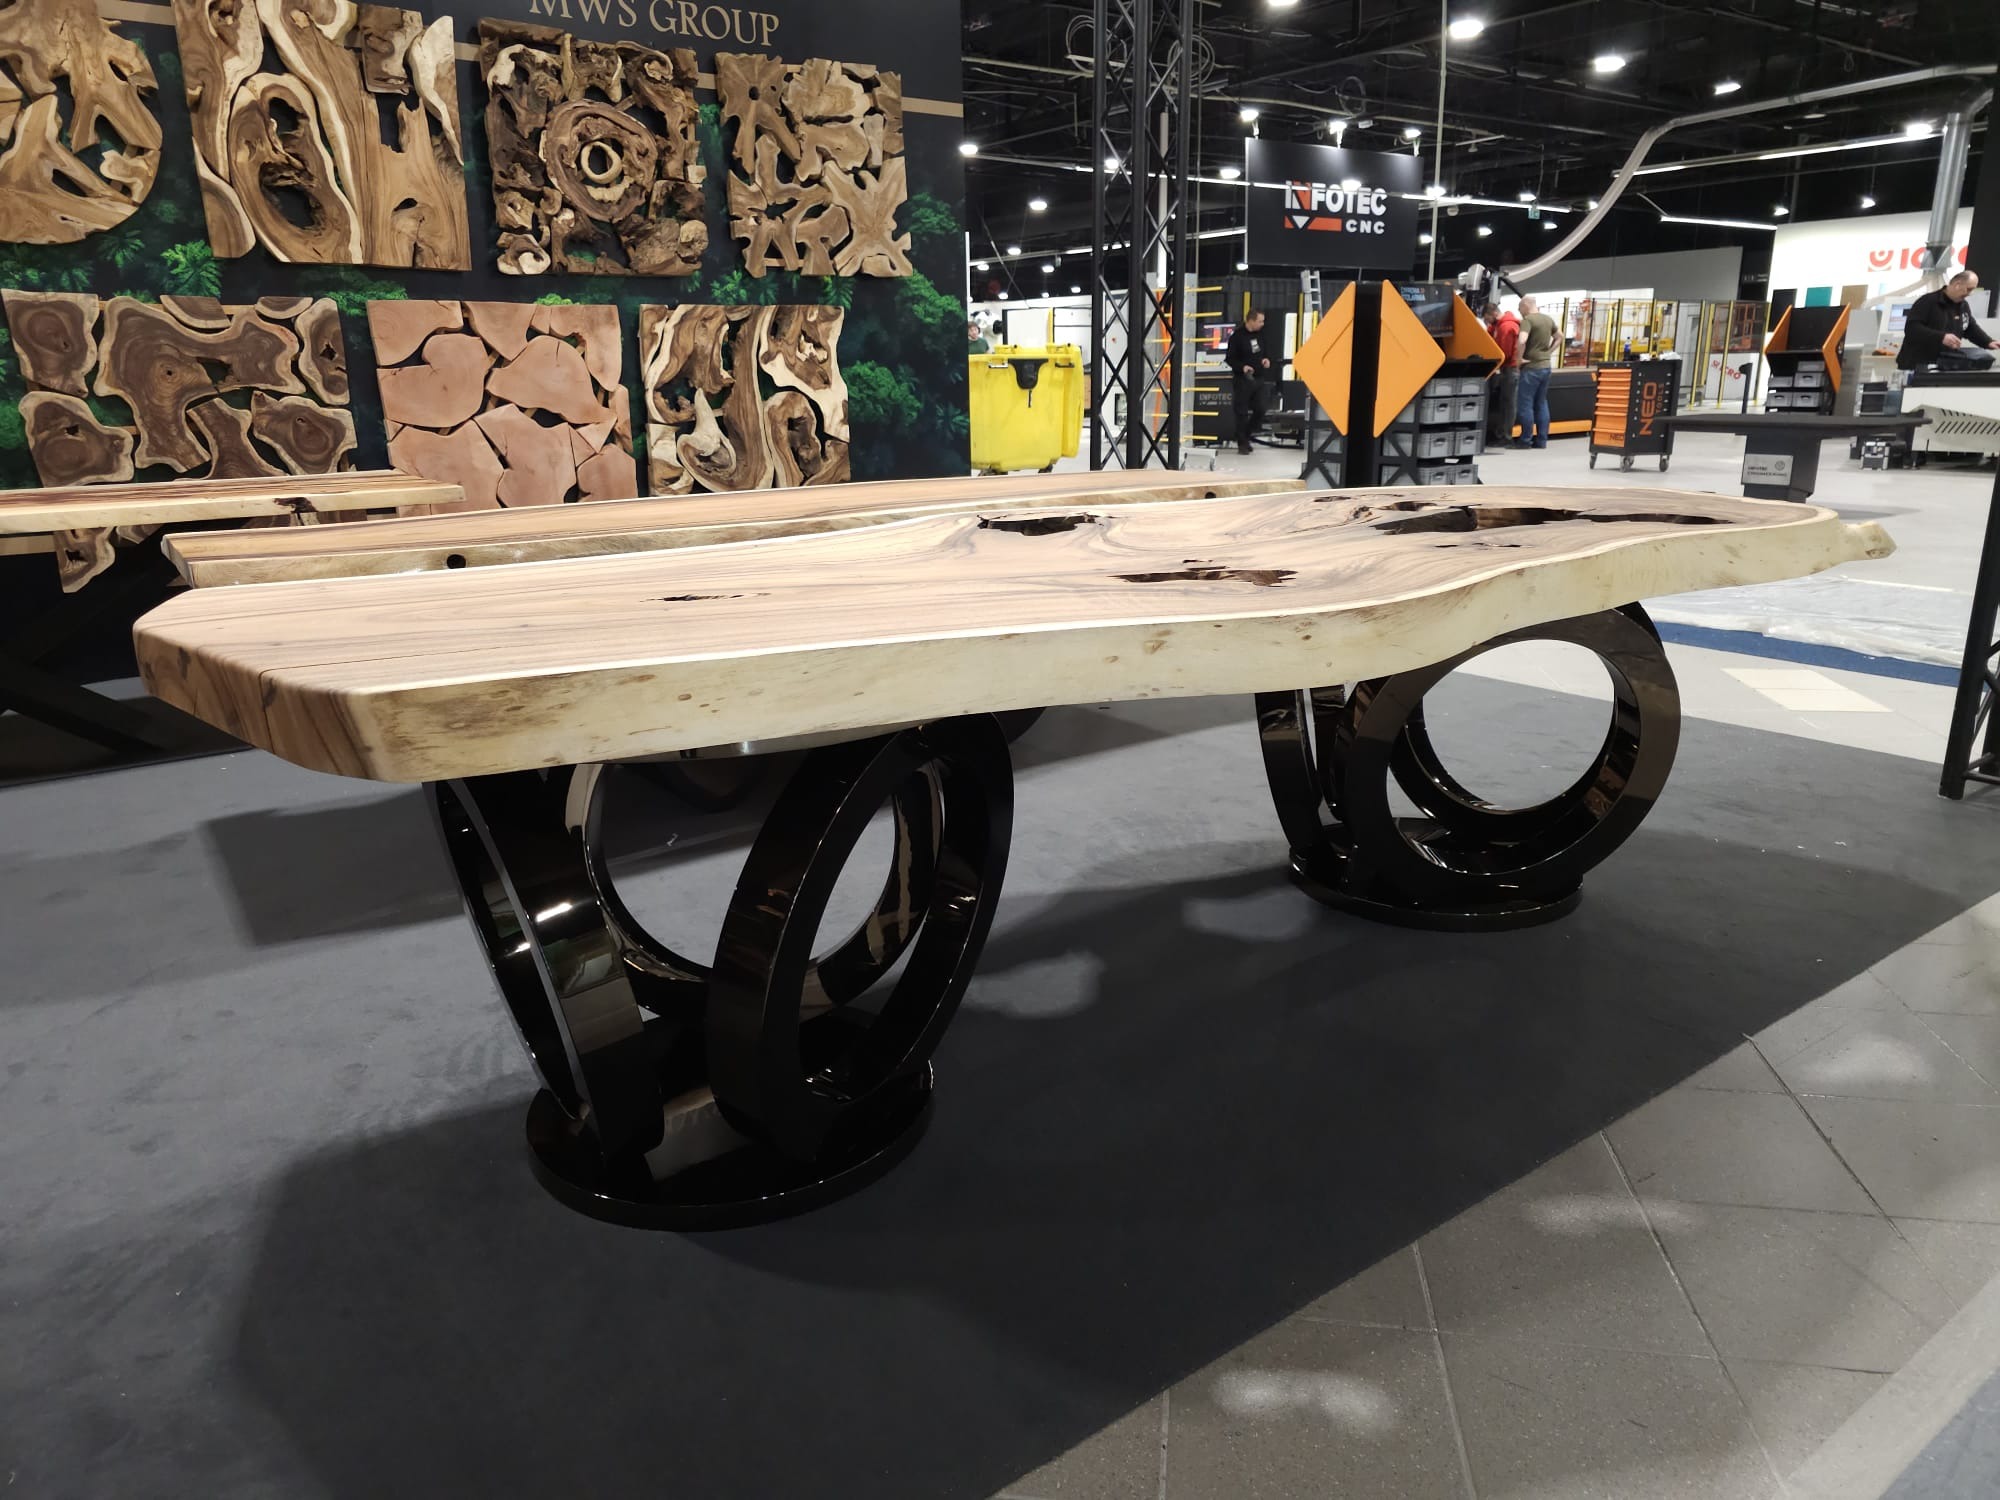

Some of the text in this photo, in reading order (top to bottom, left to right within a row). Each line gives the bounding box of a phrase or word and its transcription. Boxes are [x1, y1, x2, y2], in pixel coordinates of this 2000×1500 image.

[529, 0, 780, 47] MWS GROUP
[1285, 180, 1387, 216] INFOTEC
[1345, 219, 1385, 234] CNC
[1640, 382, 1657, 435] NEO
